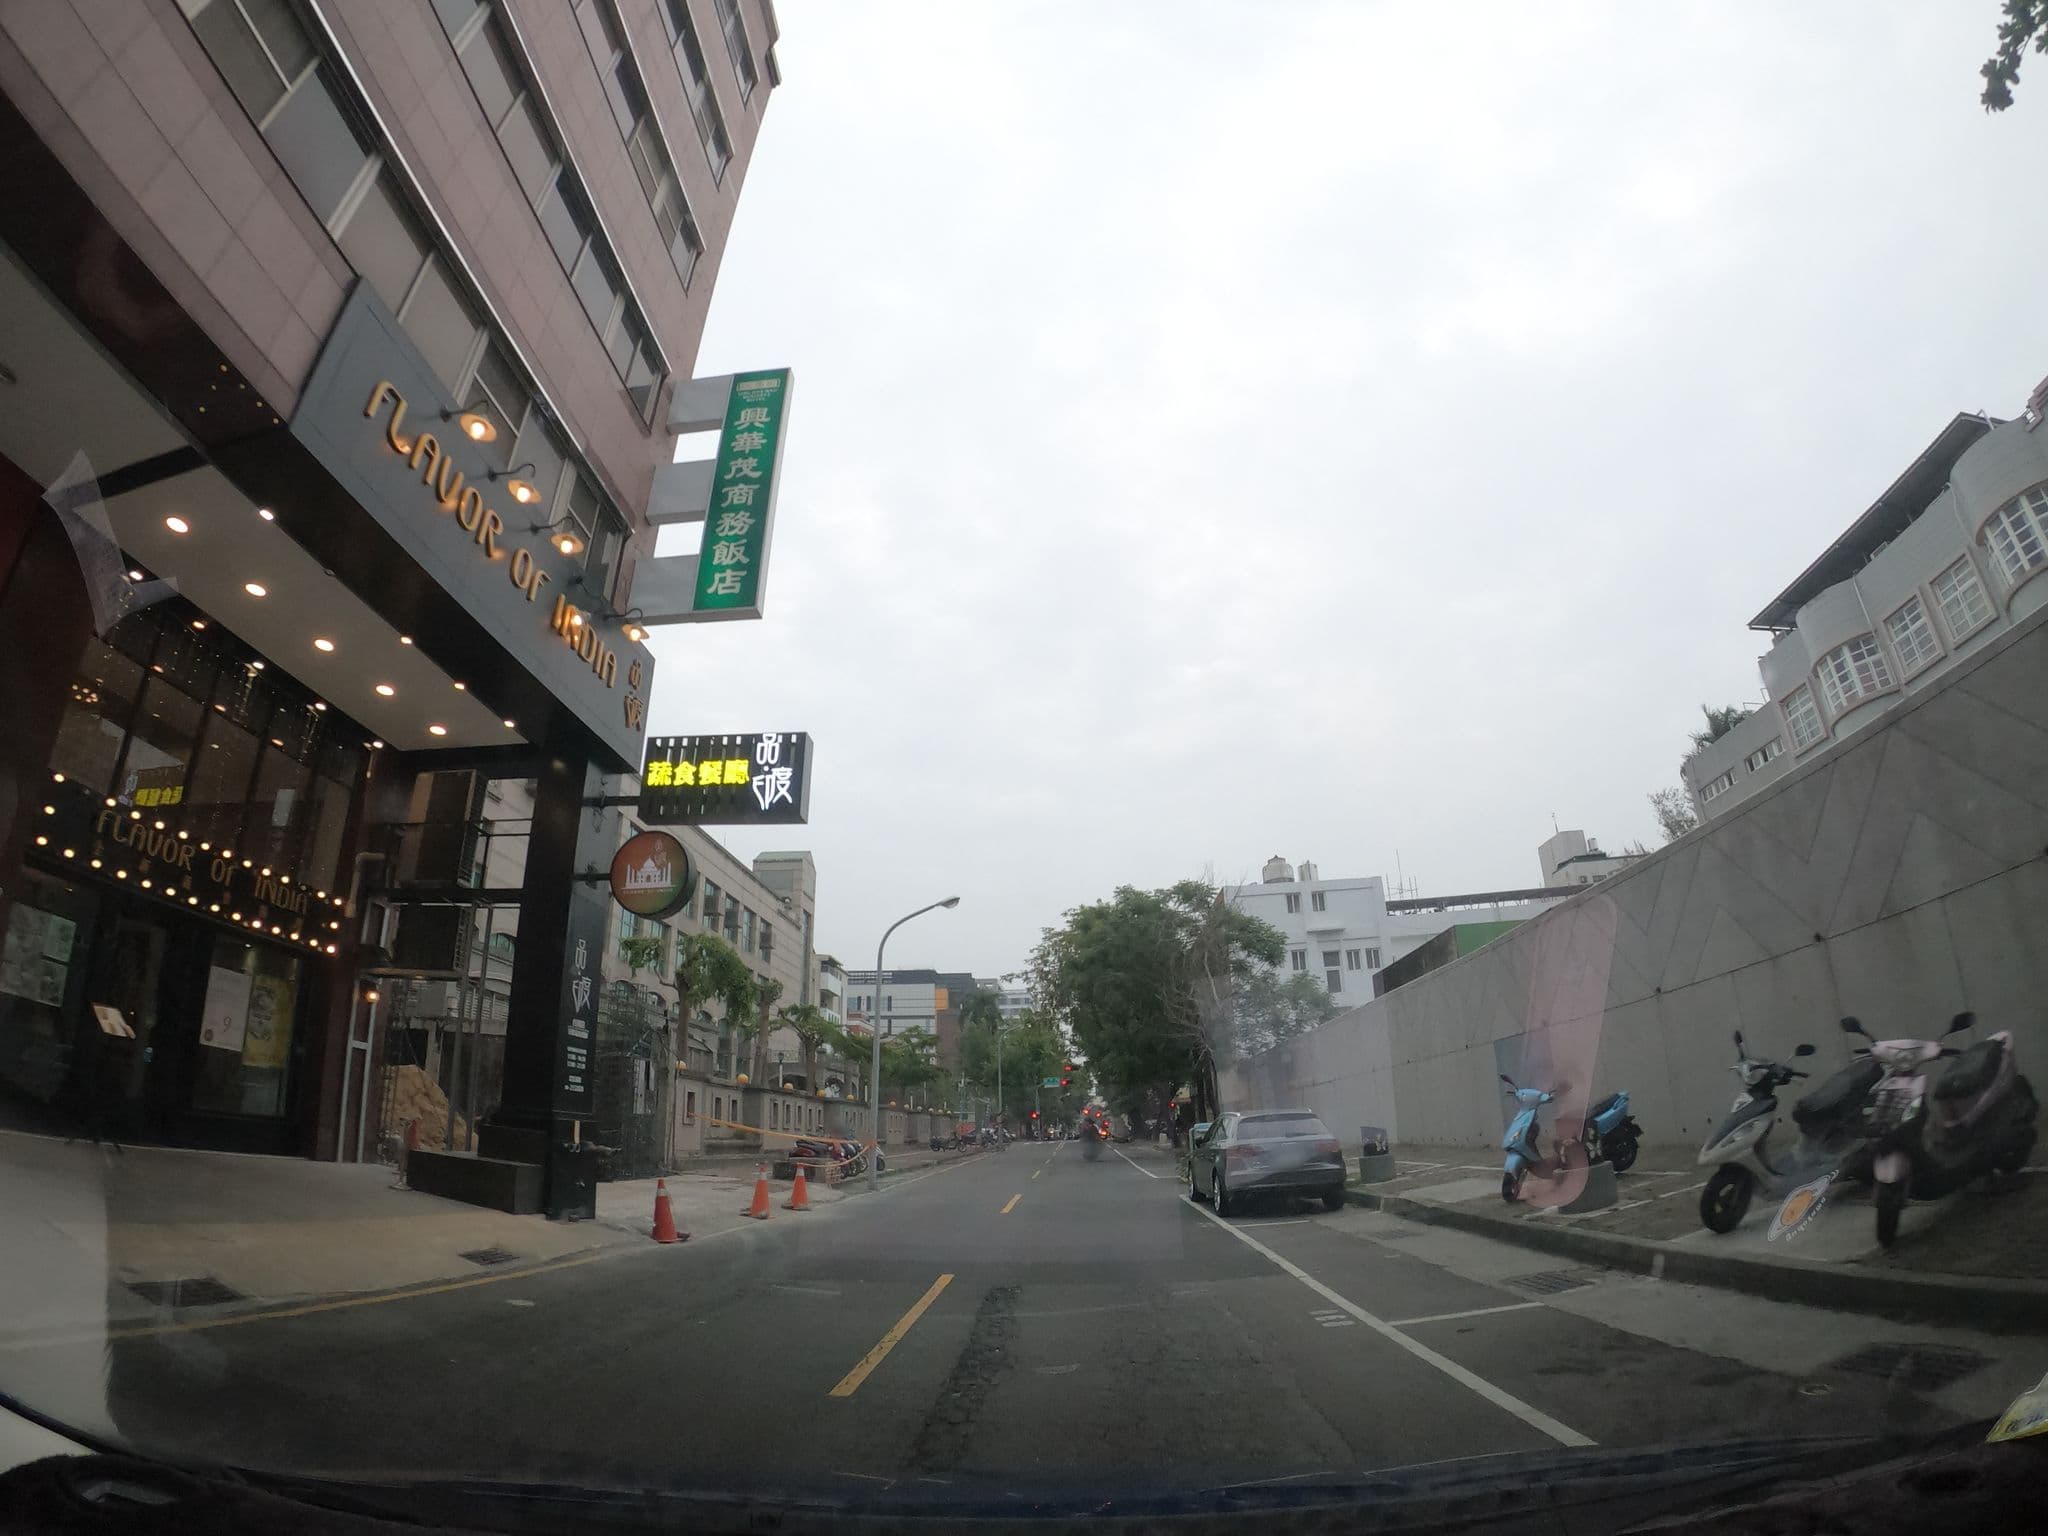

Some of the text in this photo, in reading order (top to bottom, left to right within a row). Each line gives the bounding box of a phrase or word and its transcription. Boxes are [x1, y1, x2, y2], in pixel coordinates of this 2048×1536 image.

[364, 380, 617, 688] FLAVOR OF INDIA
[706, 407, 770, 596] 興華茂商務飯店
[647, 759, 750, 786] 蔬食餐廳
[96, 809, 308, 915] FLAVOR OF INDIA
